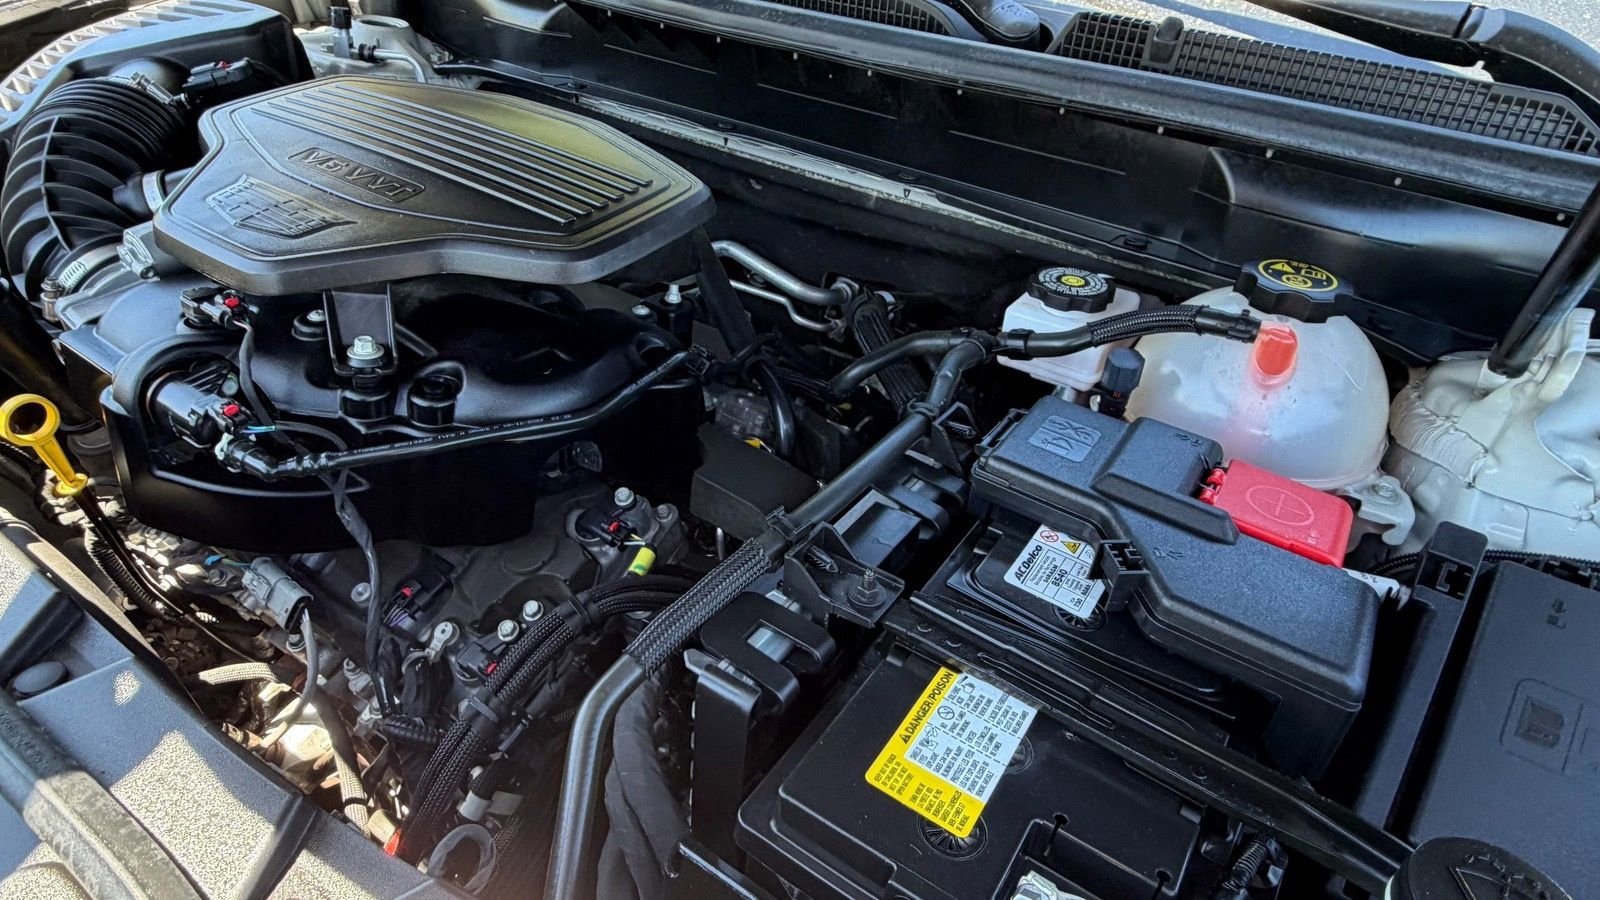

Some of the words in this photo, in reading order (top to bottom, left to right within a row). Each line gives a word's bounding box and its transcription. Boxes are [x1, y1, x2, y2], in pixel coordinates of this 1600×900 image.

[303, 151, 349, 172] V6
[345, 167, 415, 196] VVT
[1014, 544, 1043, 581] ACDelco
[1051, 568, 1068, 586] 8540
[1073, 597, 1083, 607] 730
[906, 671, 954, 736] DANGER/POISON
